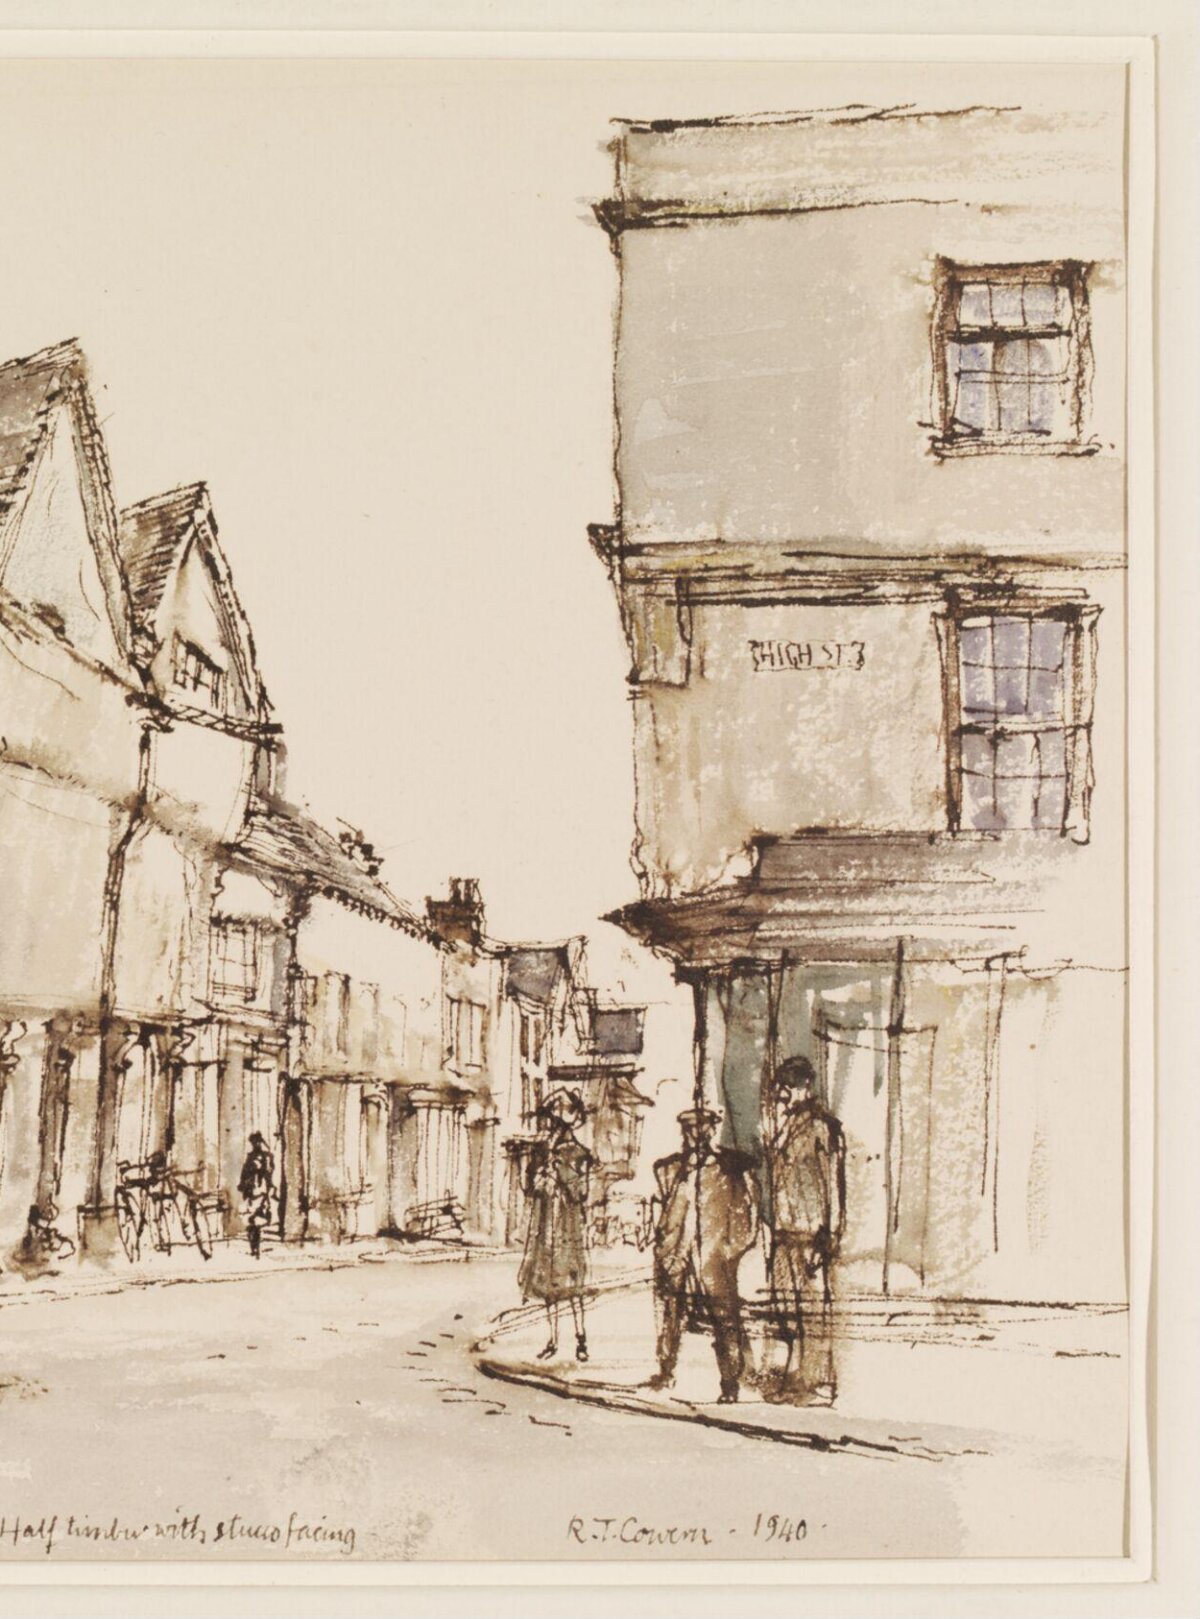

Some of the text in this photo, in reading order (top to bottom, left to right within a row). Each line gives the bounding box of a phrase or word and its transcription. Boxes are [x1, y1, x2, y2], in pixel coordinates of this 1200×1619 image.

[760, 641, 813, 670] HIGH
[0, 1515, 58, 1554] Half
[155, 1506, 205, 1544] with
[213, 1514, 281, 1543] stucco
[285, 1511, 356, 1555] facing
[753, 1512, 808, 1543] 1940
